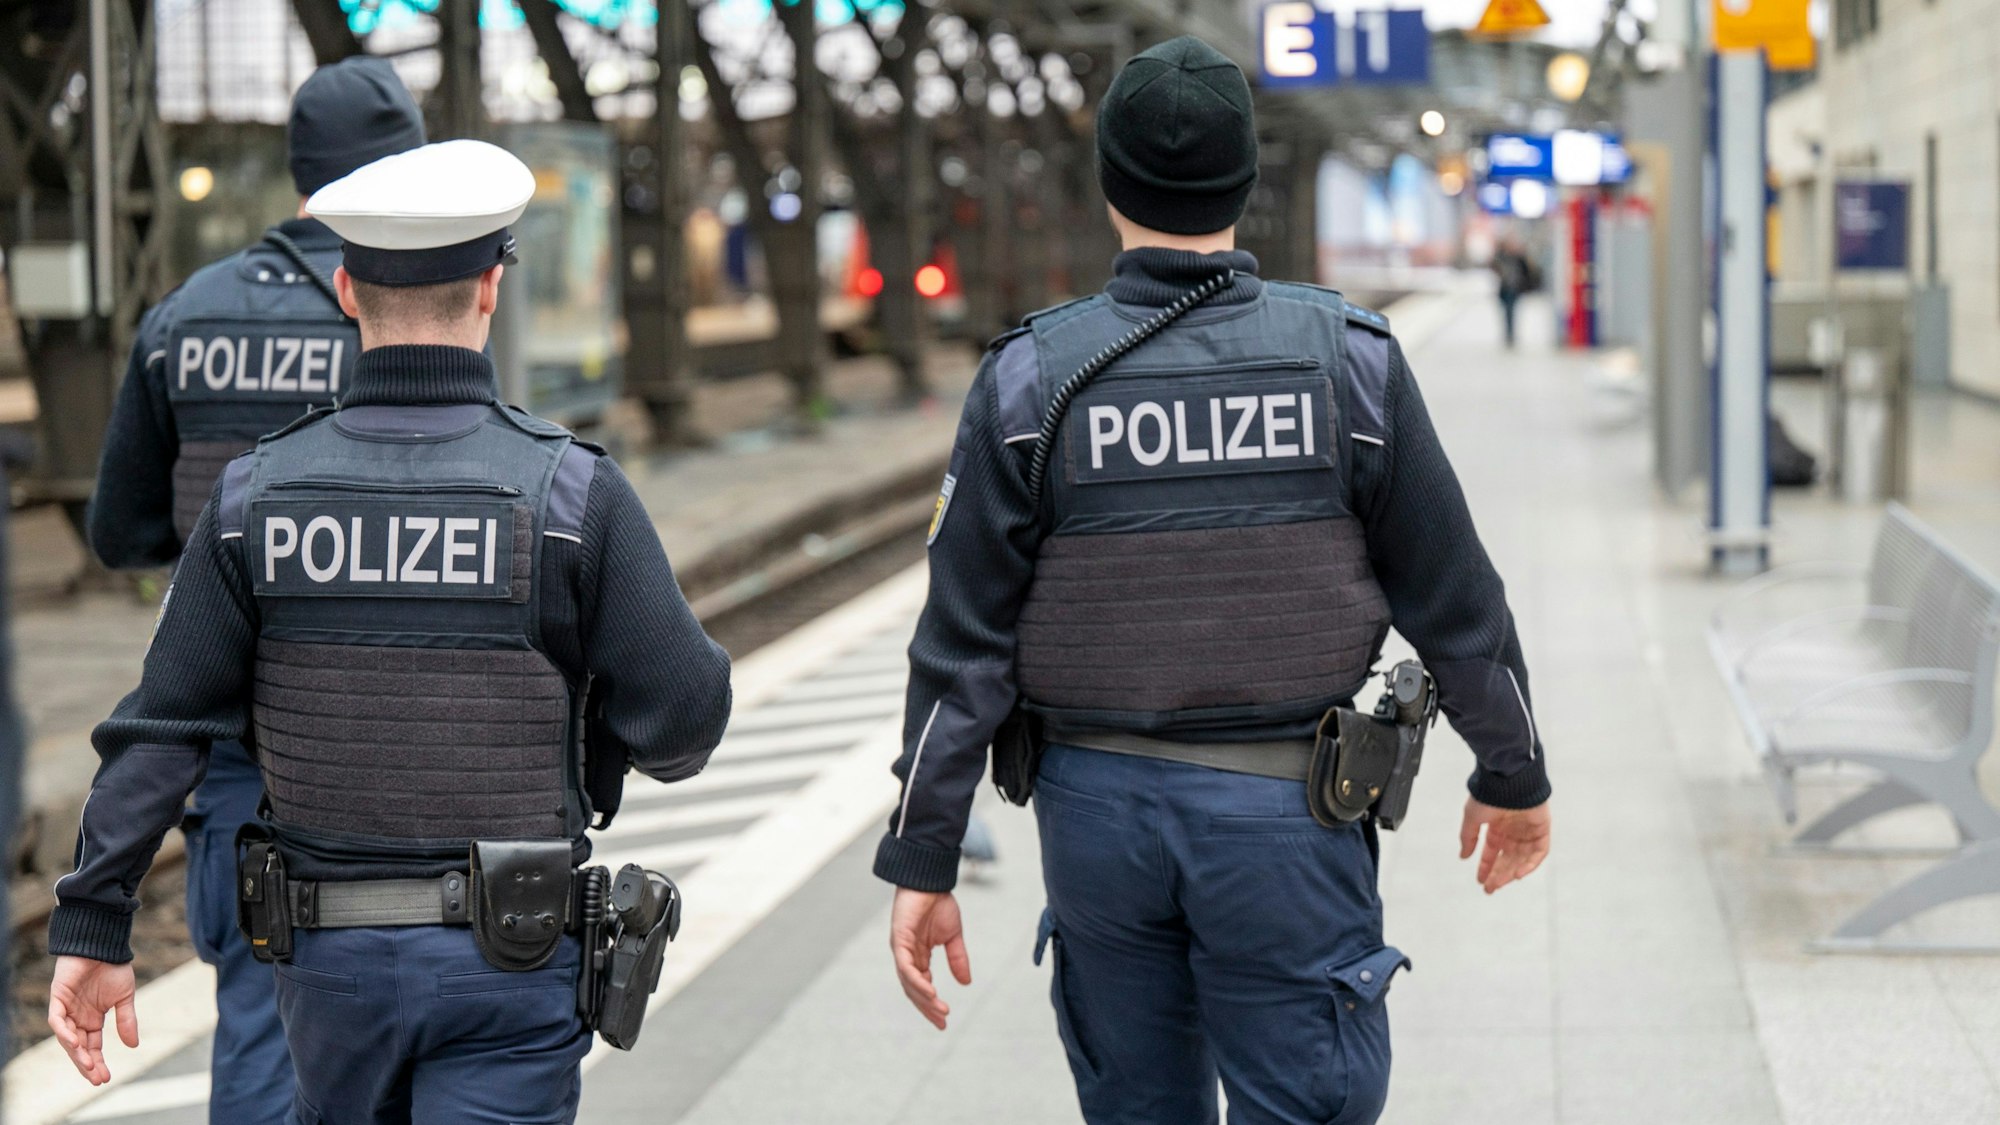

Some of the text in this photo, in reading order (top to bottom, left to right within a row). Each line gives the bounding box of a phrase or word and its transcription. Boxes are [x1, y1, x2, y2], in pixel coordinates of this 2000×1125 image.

[1264, 2, 1317, 77] E
[178, 336, 344, 392] POLIZEI
[1088, 393, 1315, 469] POLIZEI
[265, 515, 497, 584] POLIZEI
